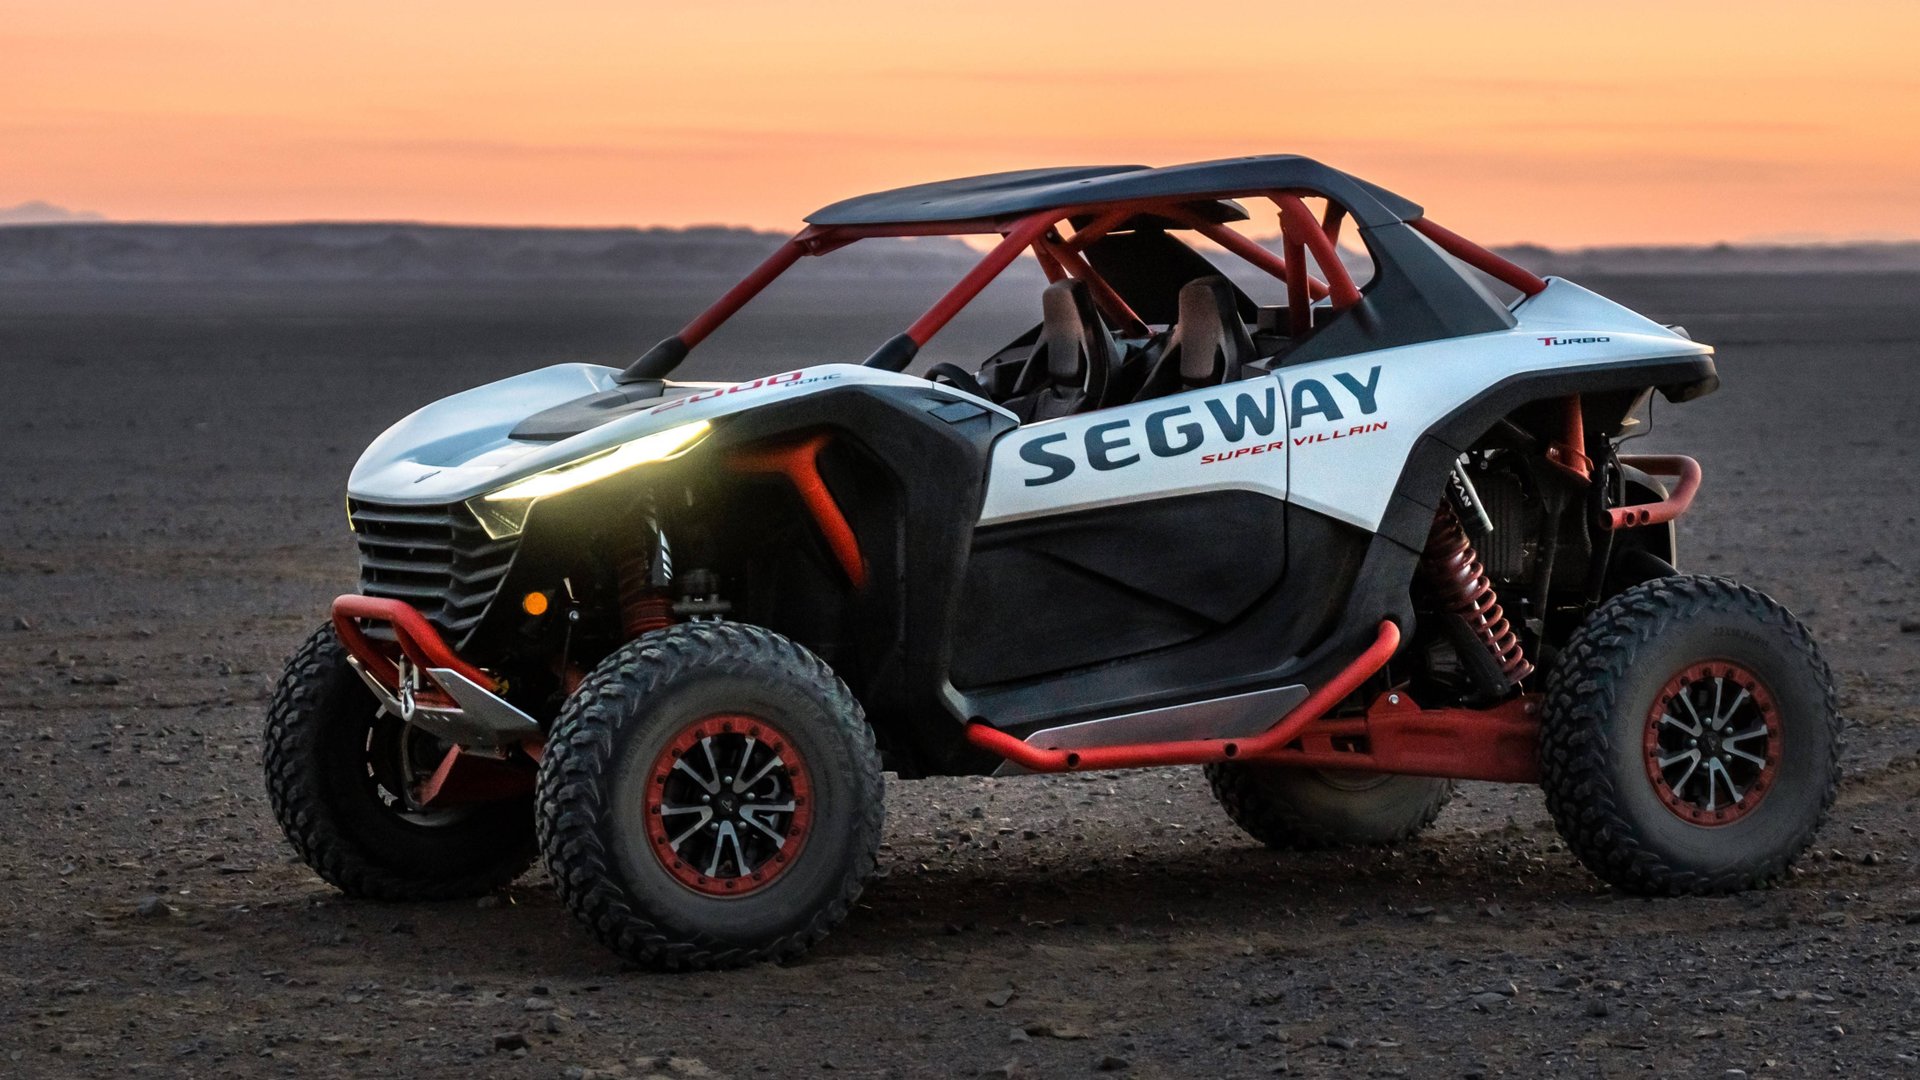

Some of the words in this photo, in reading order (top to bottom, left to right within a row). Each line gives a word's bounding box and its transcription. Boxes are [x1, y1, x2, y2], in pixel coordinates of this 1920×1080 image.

[1019, 365, 1382, 487] SEGWAY
[1200, 441, 1283, 464] SUPER
[1293, 421, 1388, 446] VILLAIN
